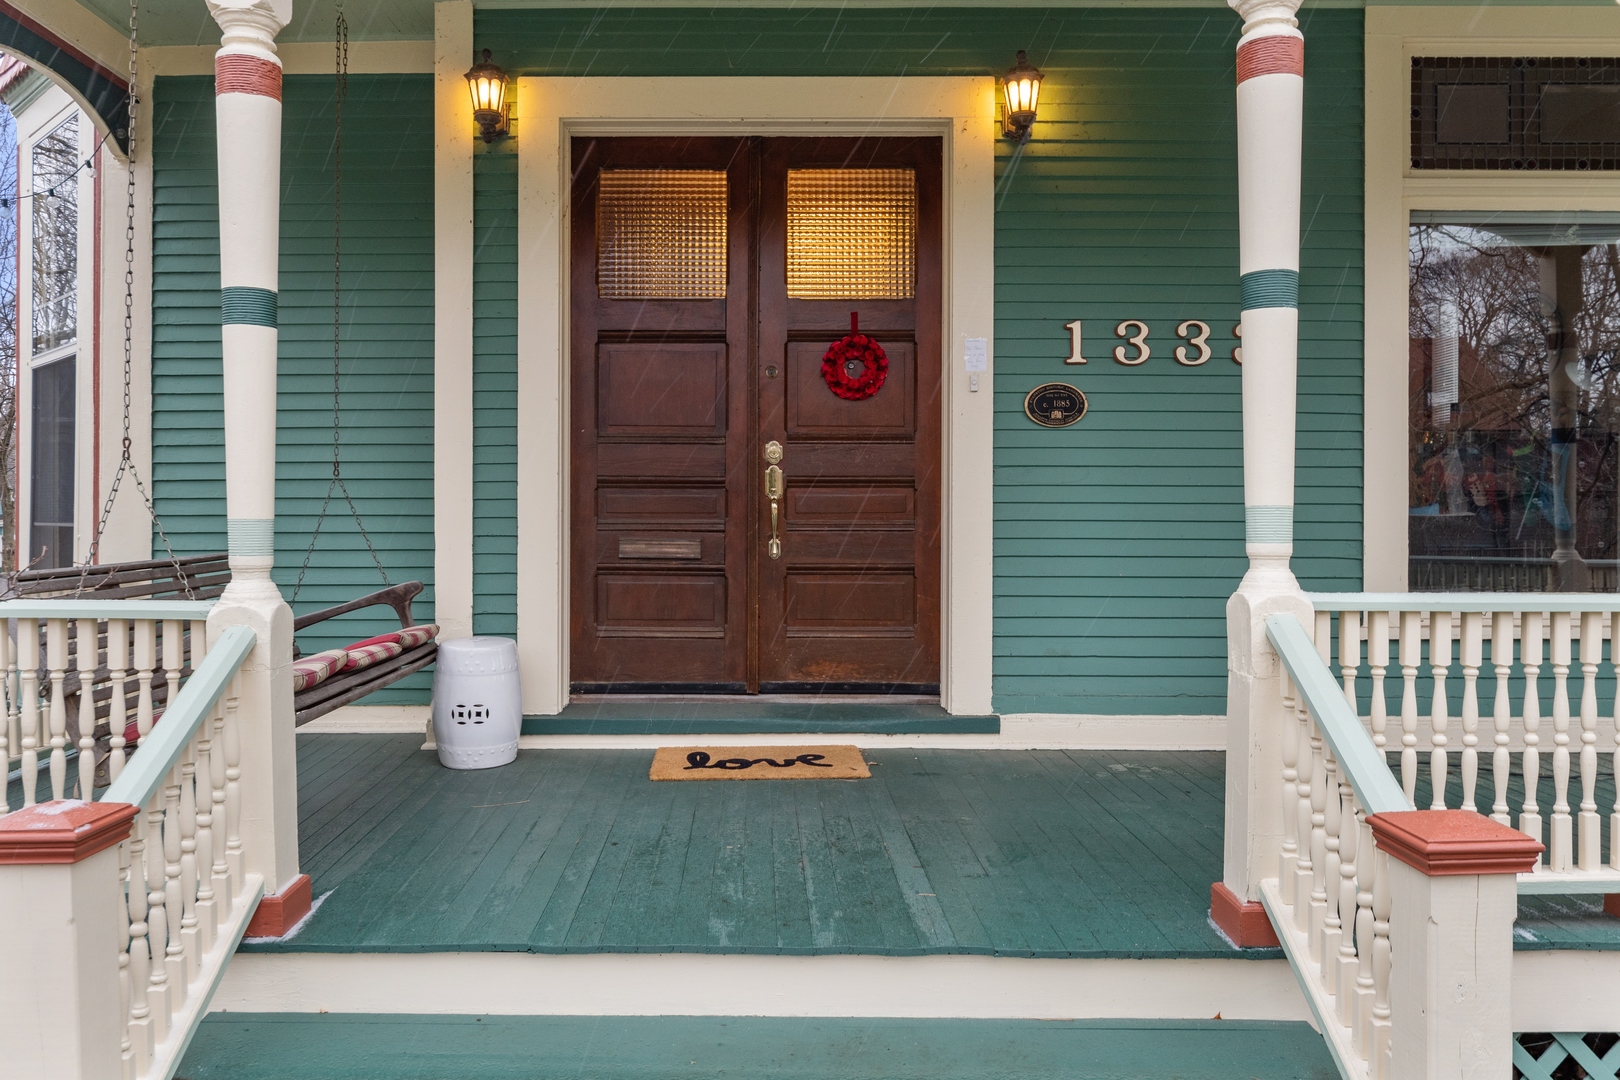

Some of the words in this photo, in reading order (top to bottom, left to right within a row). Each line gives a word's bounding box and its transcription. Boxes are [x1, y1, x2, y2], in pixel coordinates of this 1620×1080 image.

[1063, 319, 1242, 366] 133
[1053, 399, 1070, 408] 1885
[683, 751, 833, 769] love
